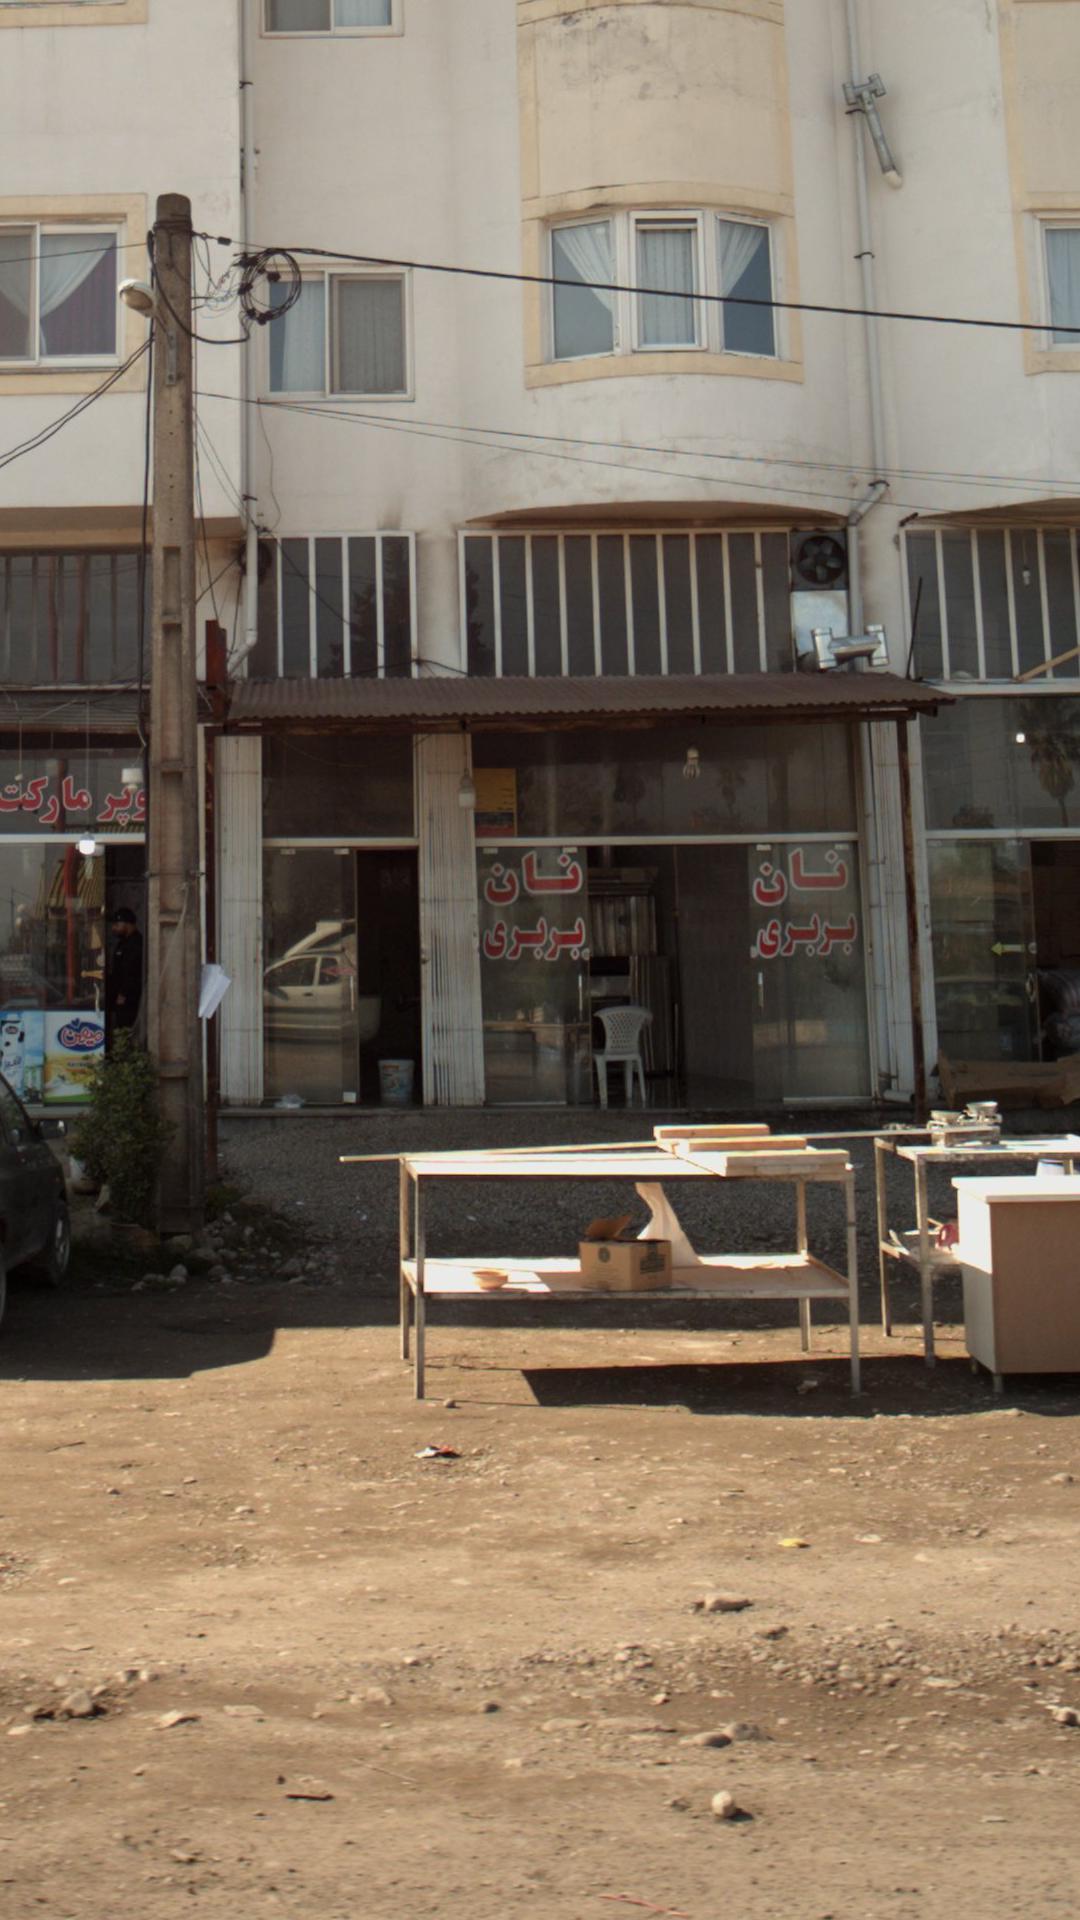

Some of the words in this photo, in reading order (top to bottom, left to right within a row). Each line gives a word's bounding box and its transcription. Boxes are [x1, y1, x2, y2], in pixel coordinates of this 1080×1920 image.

[0, 776, 92, 823] مارکت
[96, 784, 145, 826] وپر
[484, 850, 583, 906] نان
[753, 847, 848, 906] نان
[484, 916, 585, 961] بربری
[757, 912, 857, 959] بربری
